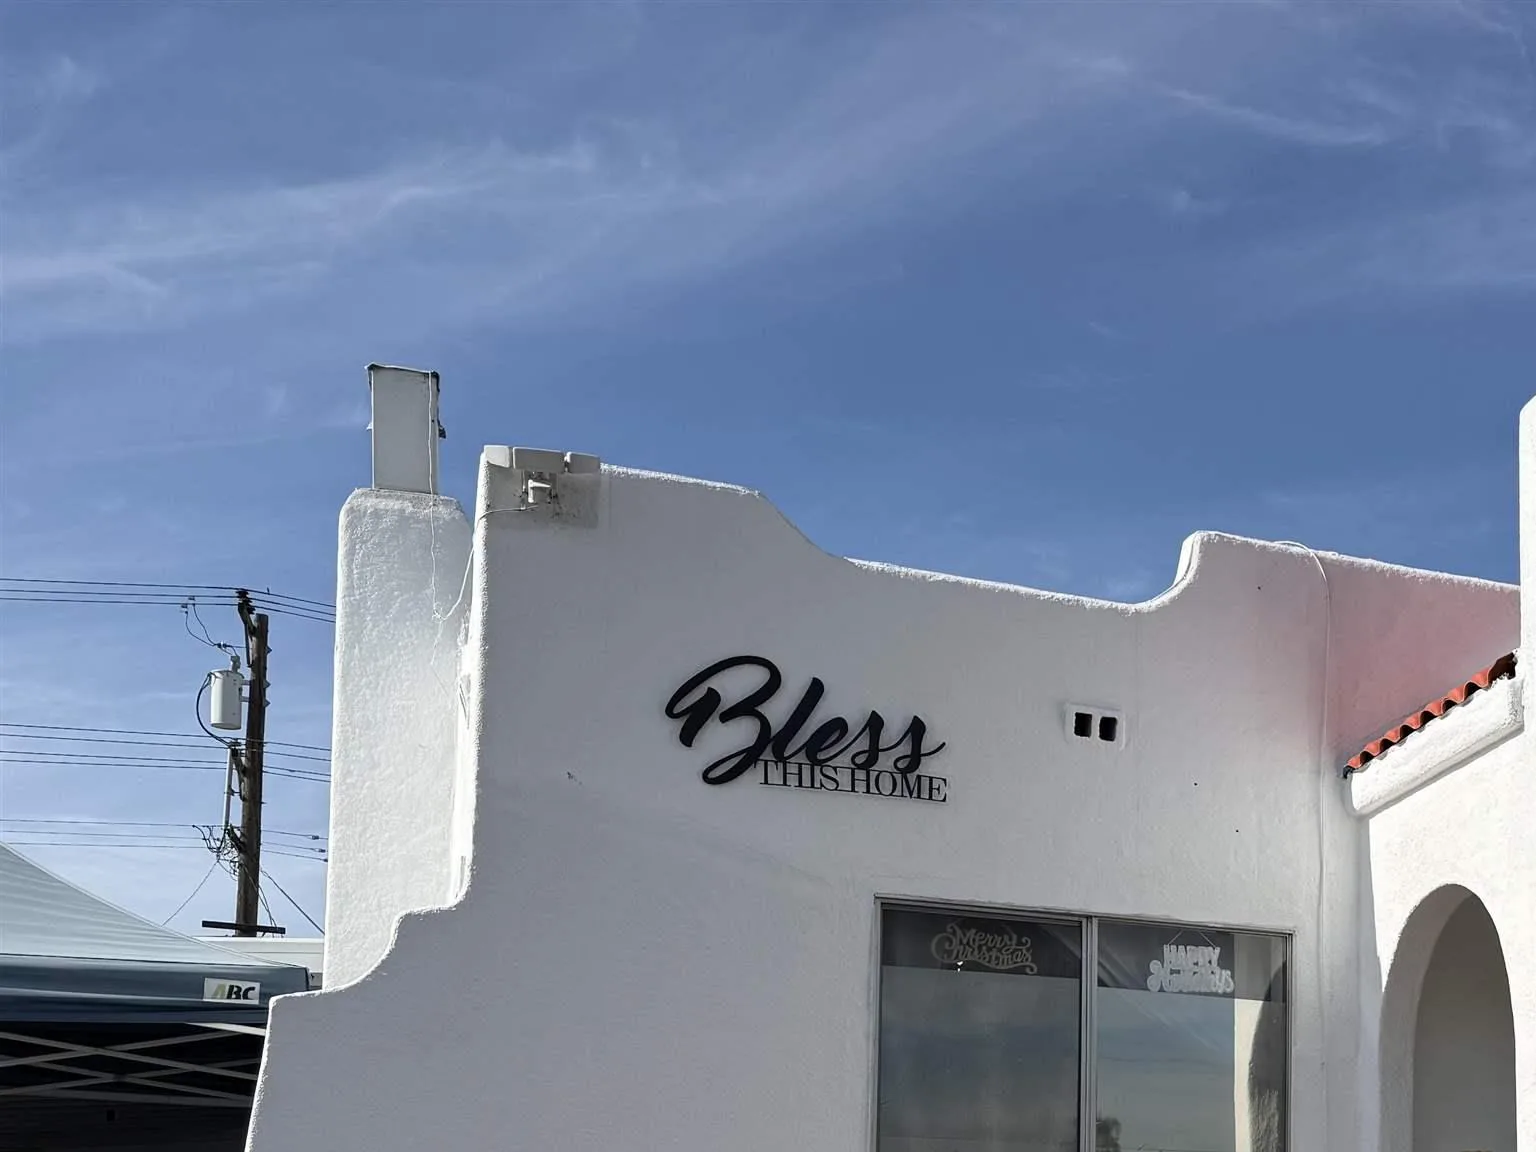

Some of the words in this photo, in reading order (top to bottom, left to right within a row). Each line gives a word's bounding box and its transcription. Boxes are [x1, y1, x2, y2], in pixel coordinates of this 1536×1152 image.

[665, 655, 947, 785] Bless
[754, 758, 841, 792] THIS
[850, 766, 949, 803] HOME
[931, 932, 1038, 975] Christmas
[946, 922, 1032, 954] Merry
[211, 983, 256, 1000] ABC
